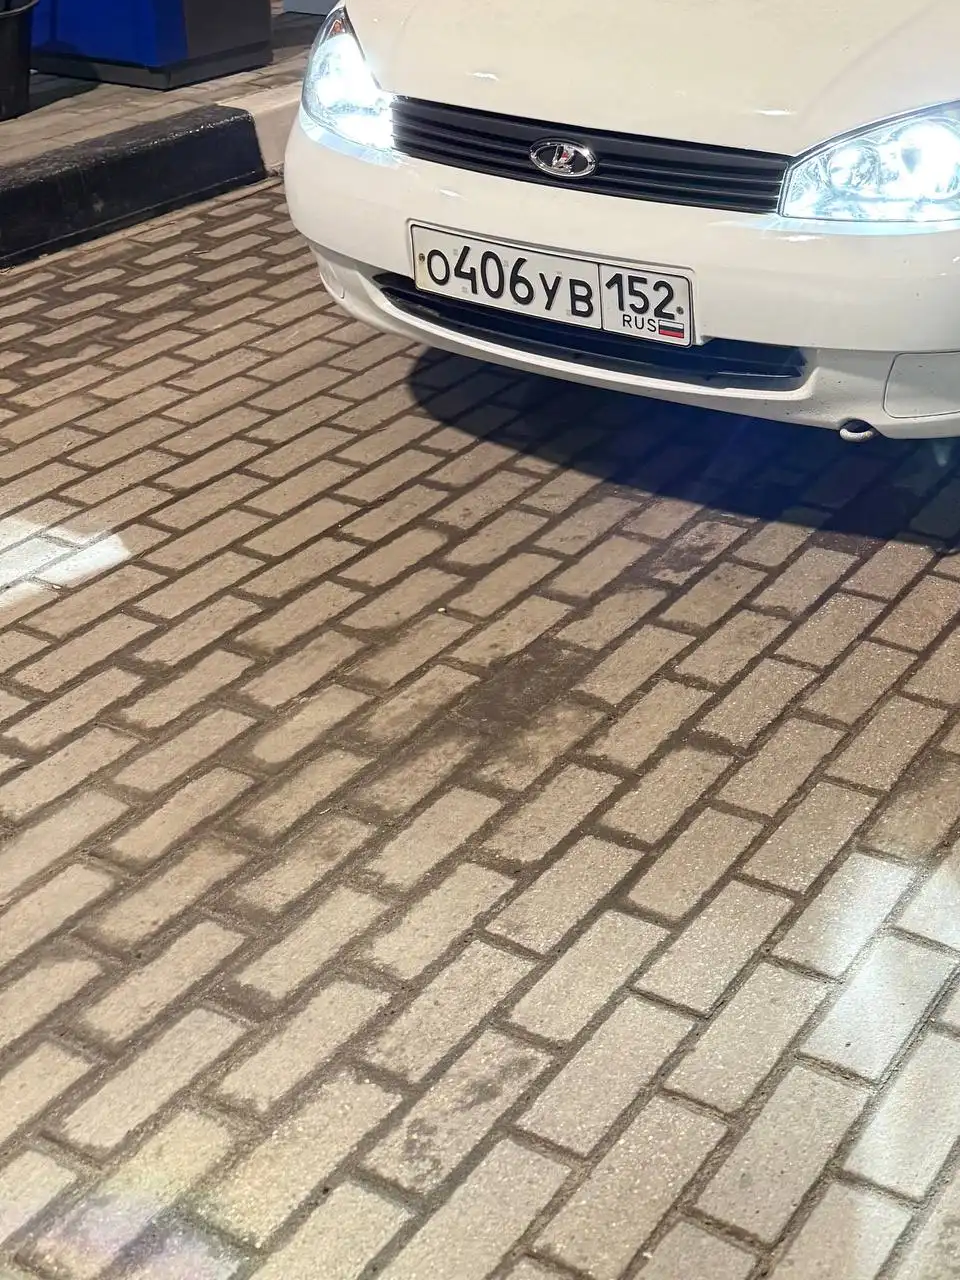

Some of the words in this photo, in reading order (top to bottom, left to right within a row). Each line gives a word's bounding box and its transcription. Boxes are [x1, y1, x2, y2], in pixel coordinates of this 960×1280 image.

[426, 245, 594, 318] О406УВ
[605, 272, 676, 321] 152
[622, 314, 657, 333] RUS
